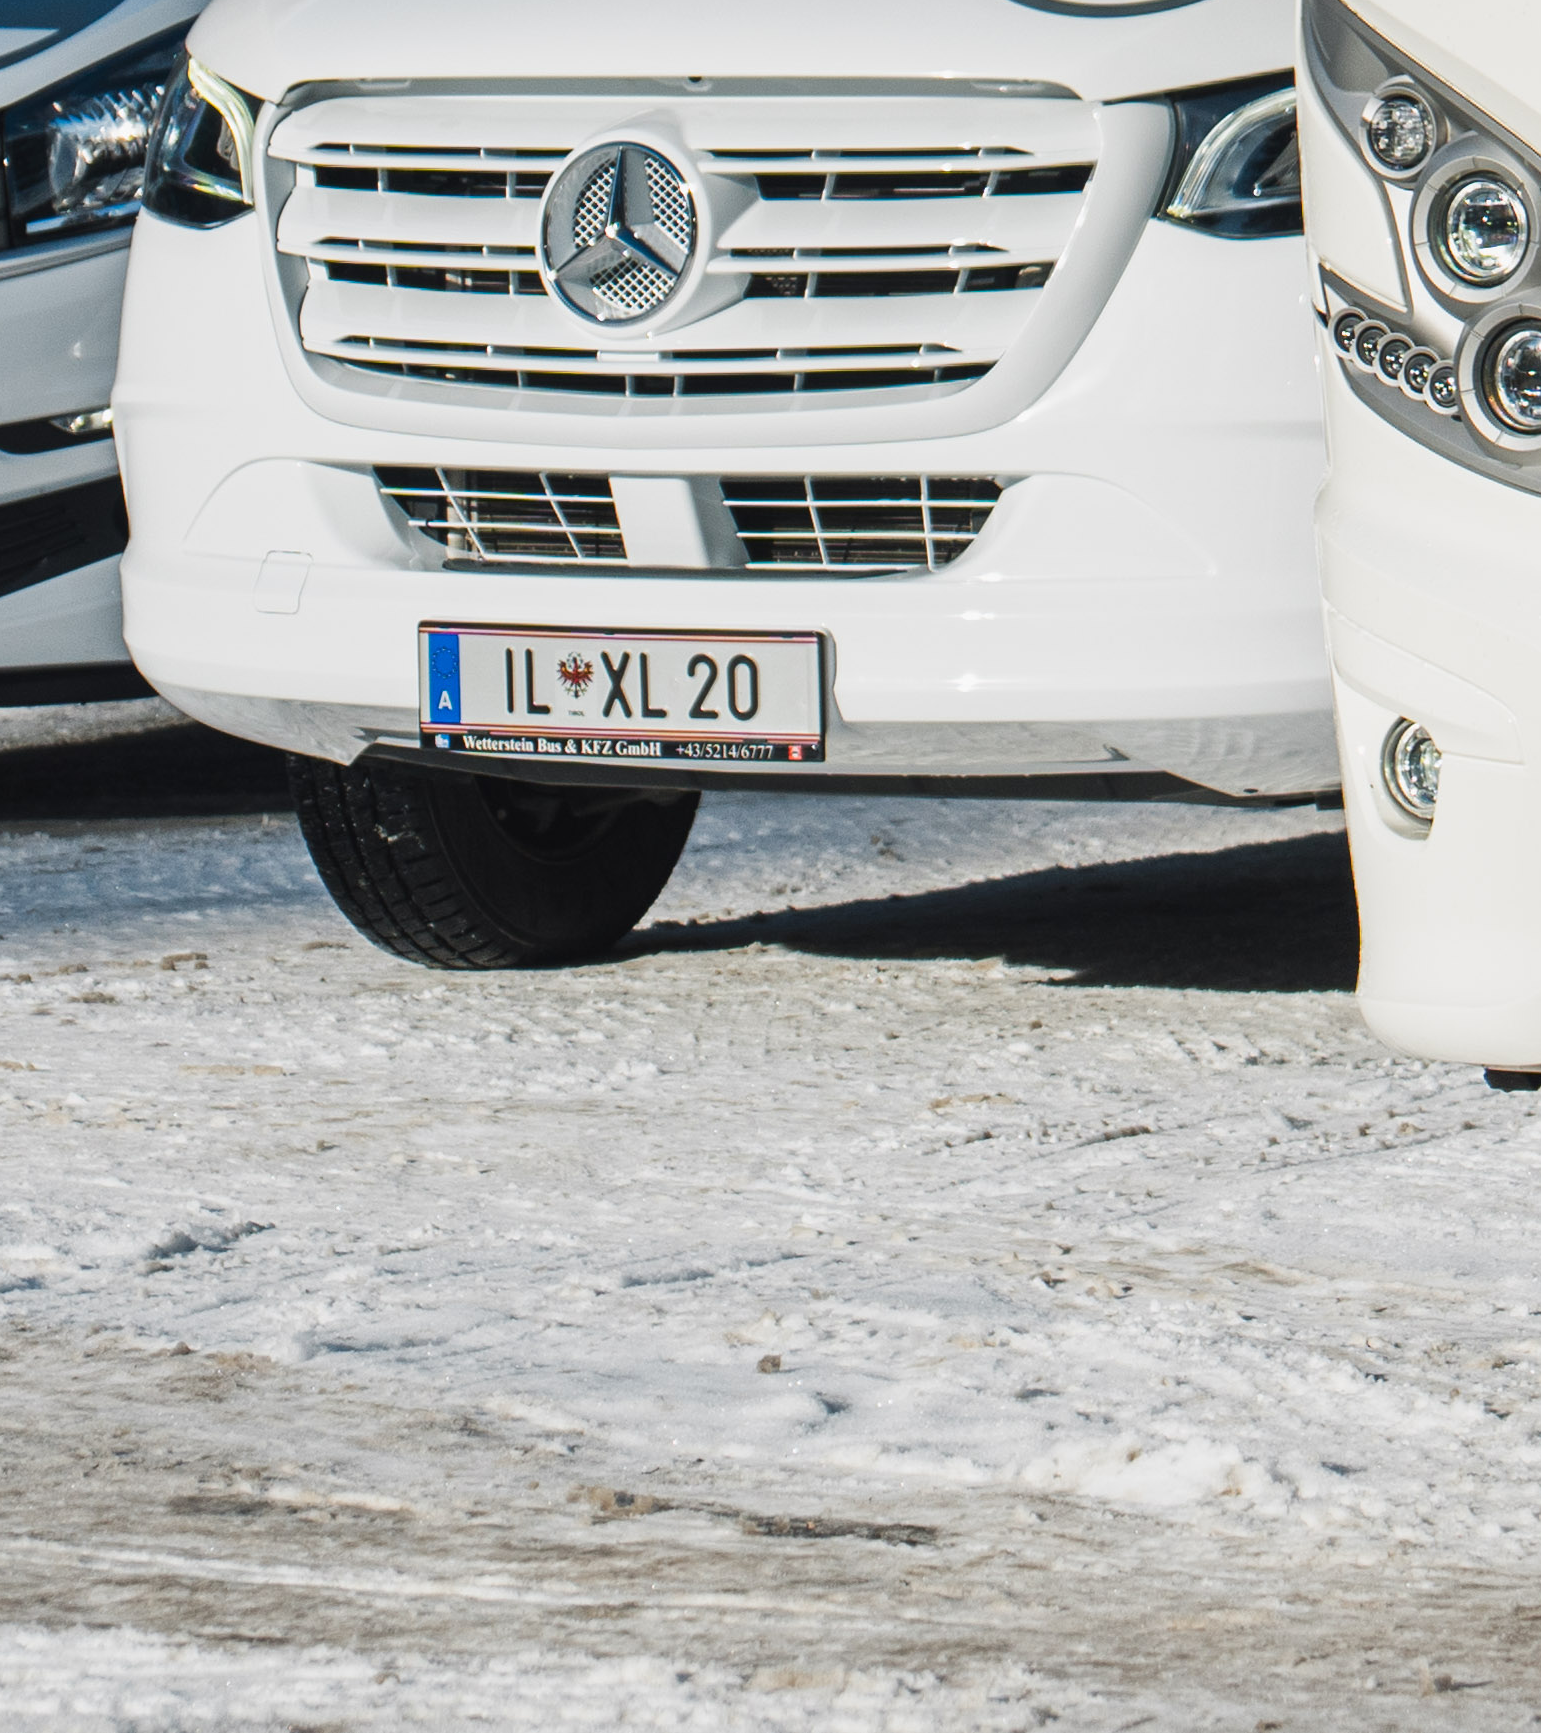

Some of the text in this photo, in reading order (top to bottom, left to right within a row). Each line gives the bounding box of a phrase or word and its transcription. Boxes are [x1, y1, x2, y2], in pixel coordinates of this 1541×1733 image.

[505, 647, 759, 721] IL XL 20
[438, 690, 453, 710] A
[462, 735, 535, 752] Wetterstein
[537, 738, 562, 753] Bus
[564, 739, 577, 754] &
[580, 740, 612, 755] KFZ
[615, 740, 662, 757] GmbH
[675, 743, 774, 760] +43/5214/6777
